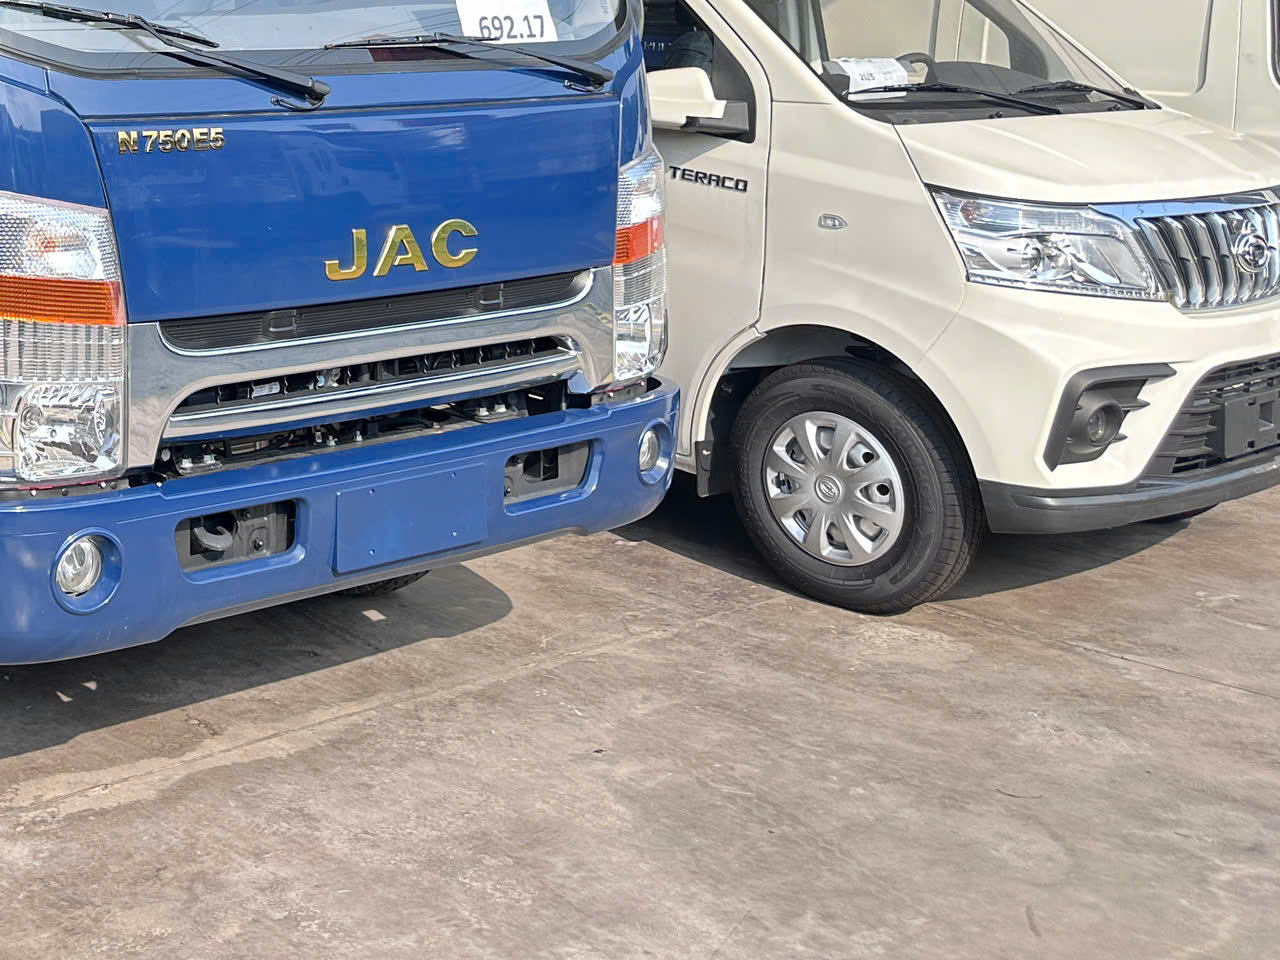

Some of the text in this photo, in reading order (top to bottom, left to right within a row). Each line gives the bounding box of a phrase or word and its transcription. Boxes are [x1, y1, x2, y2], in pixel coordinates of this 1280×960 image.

[479, 15, 545, 40] 692.17
[668, 165, 748, 192] TERACO
[323, 218, 479, 281] JAC
